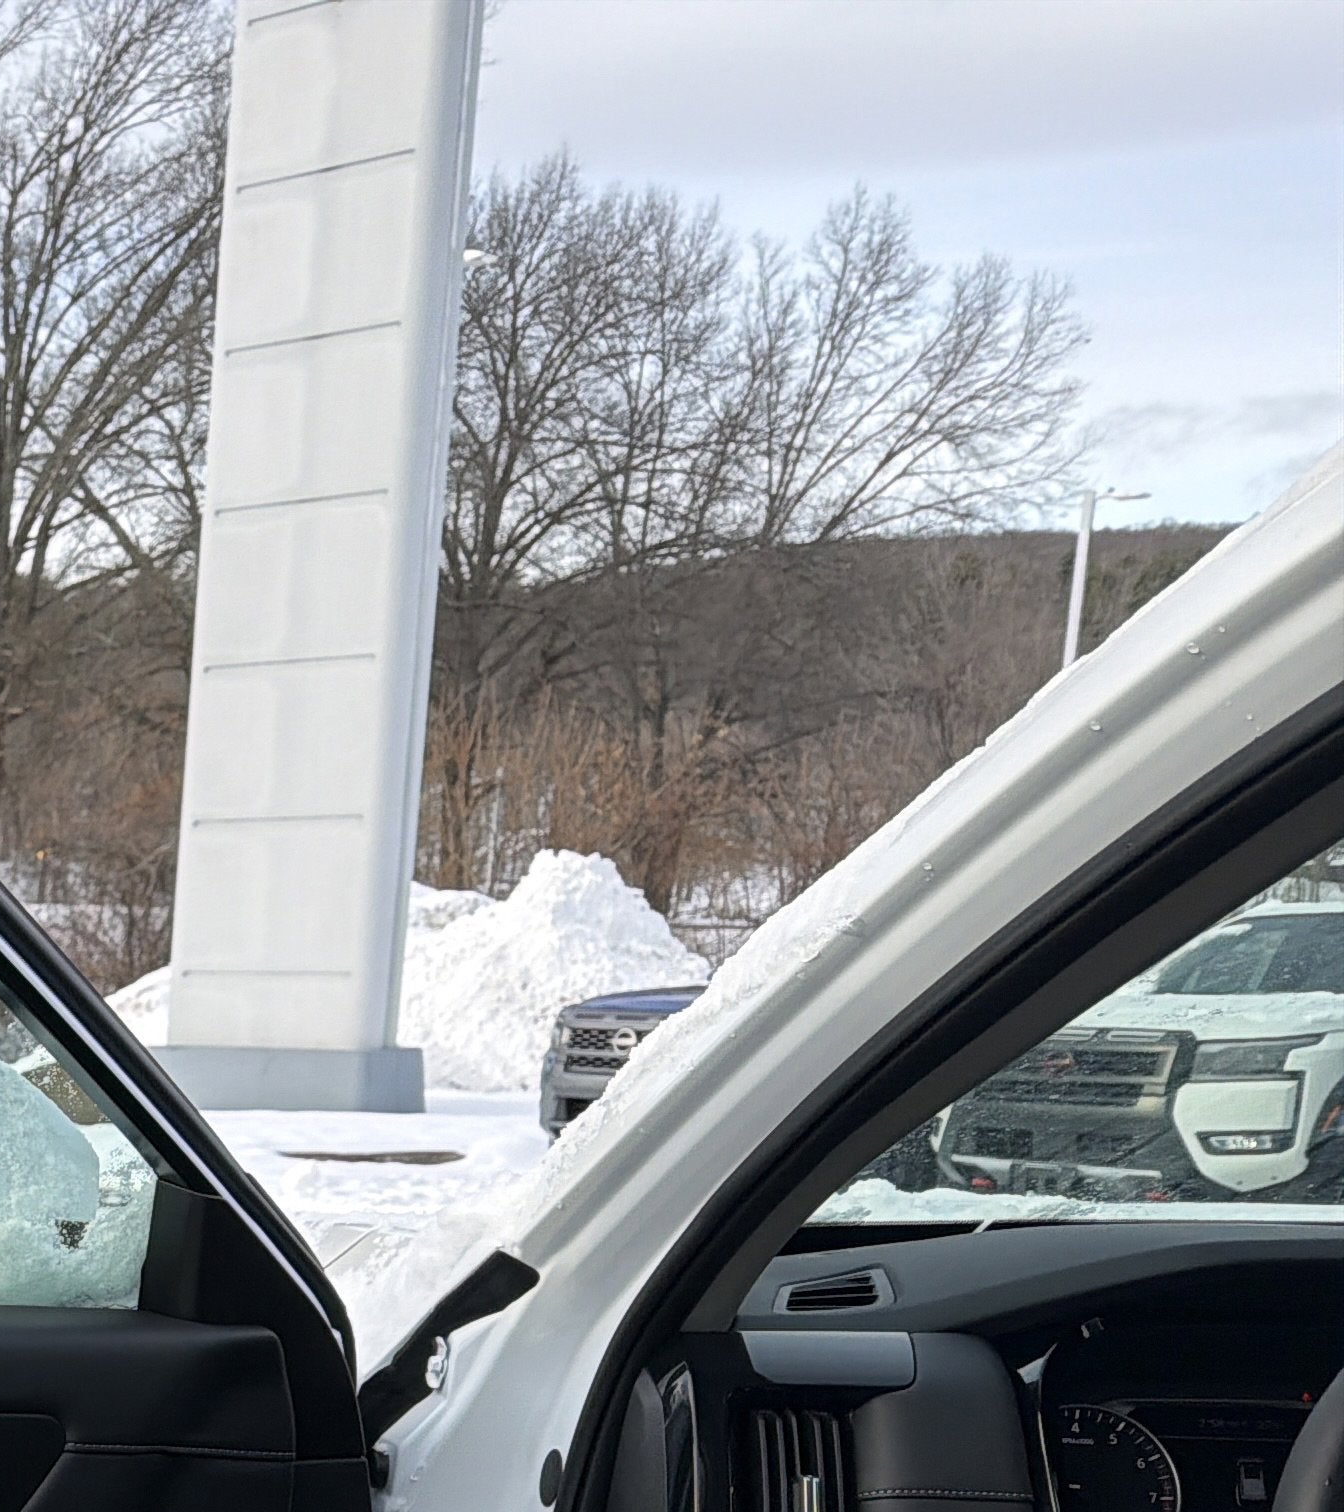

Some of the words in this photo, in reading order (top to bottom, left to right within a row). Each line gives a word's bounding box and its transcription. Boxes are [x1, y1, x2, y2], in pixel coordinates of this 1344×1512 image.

[1071, 1422, 1080, 1433] 4
[1109, 1433, 1118, 1445] 5
[1136, 1458, 1146, 1469] 6
[1149, 1492, 1158, 1503] 7
